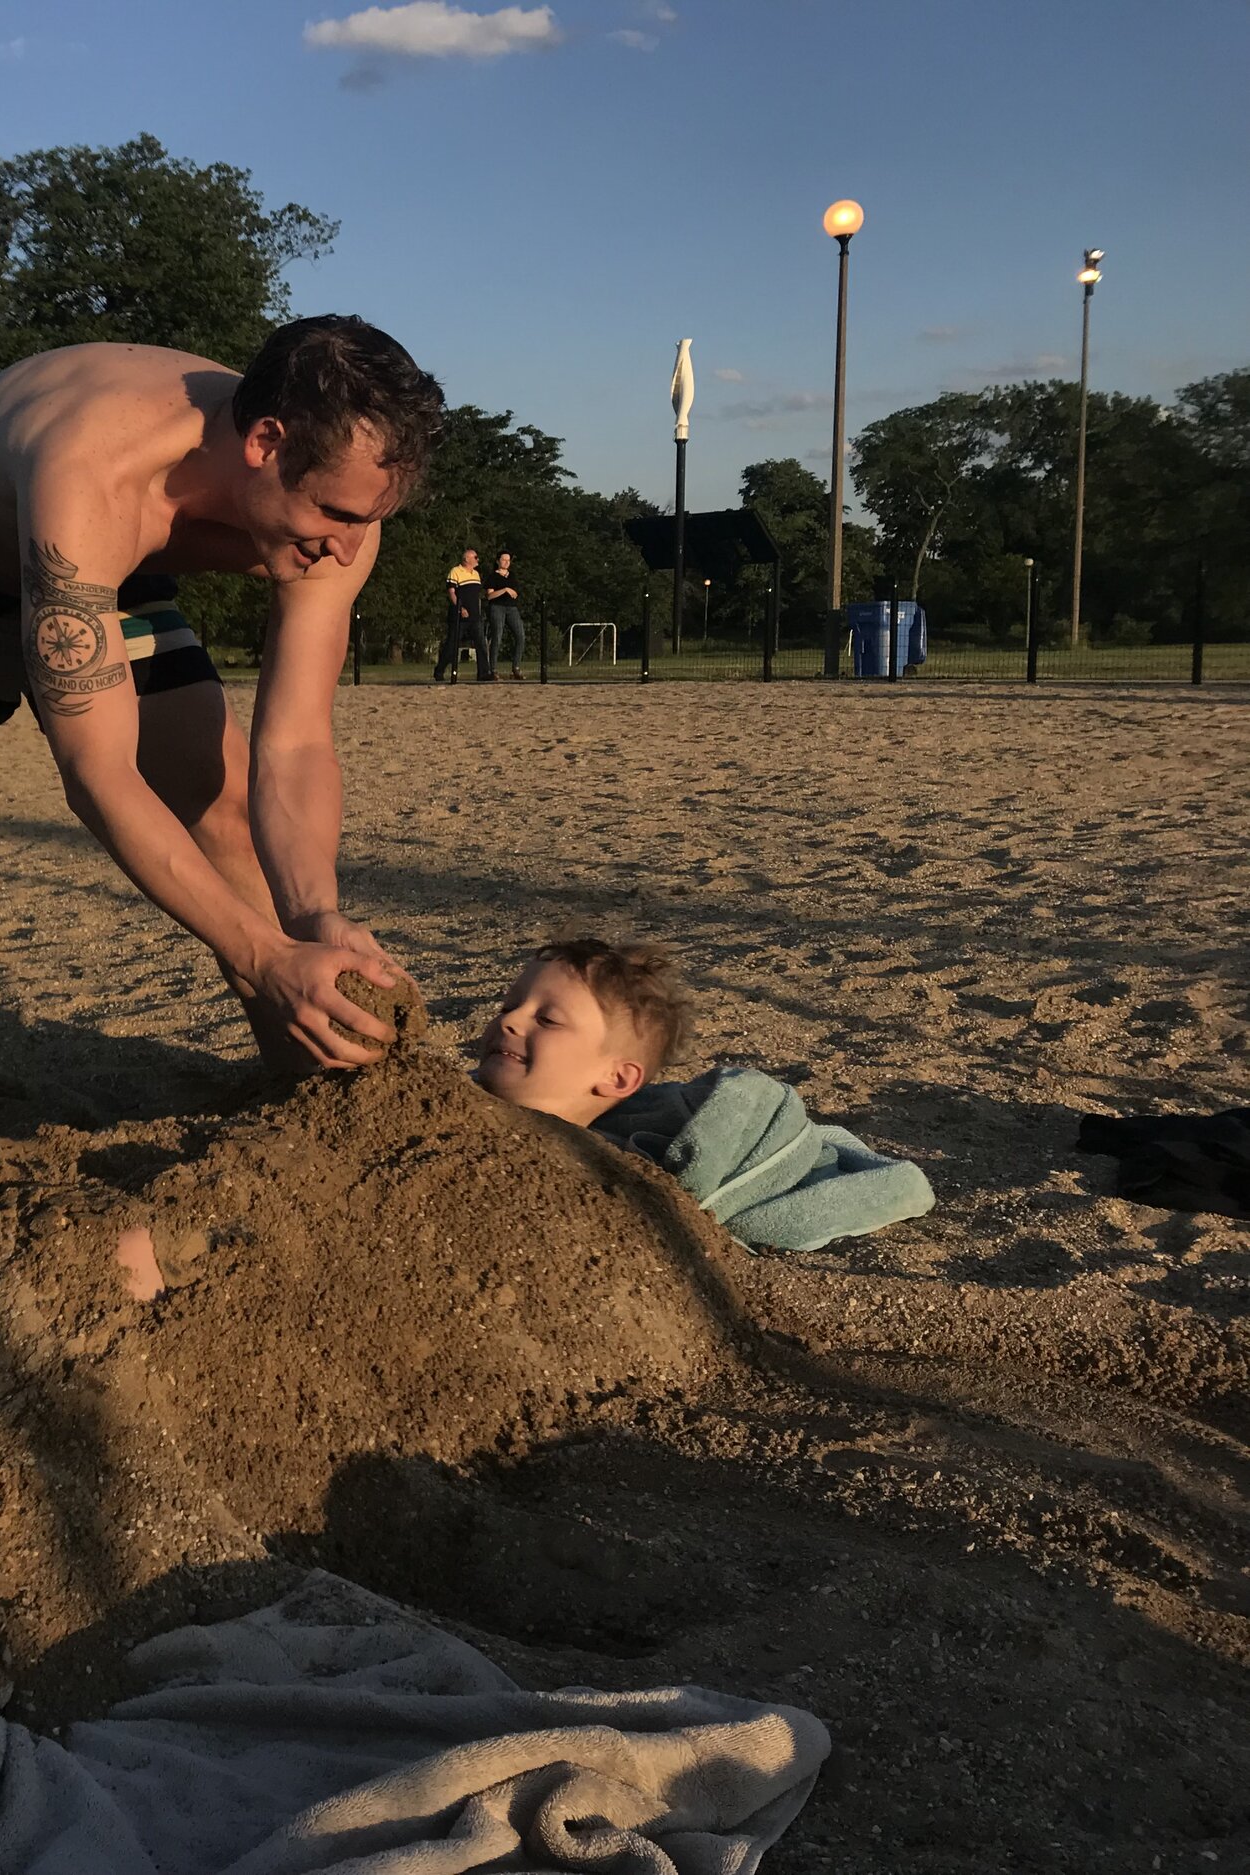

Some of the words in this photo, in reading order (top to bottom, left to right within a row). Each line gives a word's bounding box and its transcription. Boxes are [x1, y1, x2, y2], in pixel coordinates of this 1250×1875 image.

[58, 678, 76, 690] AND
[79, 679, 93, 691] GO
[96, 671, 124, 687] NORTH
